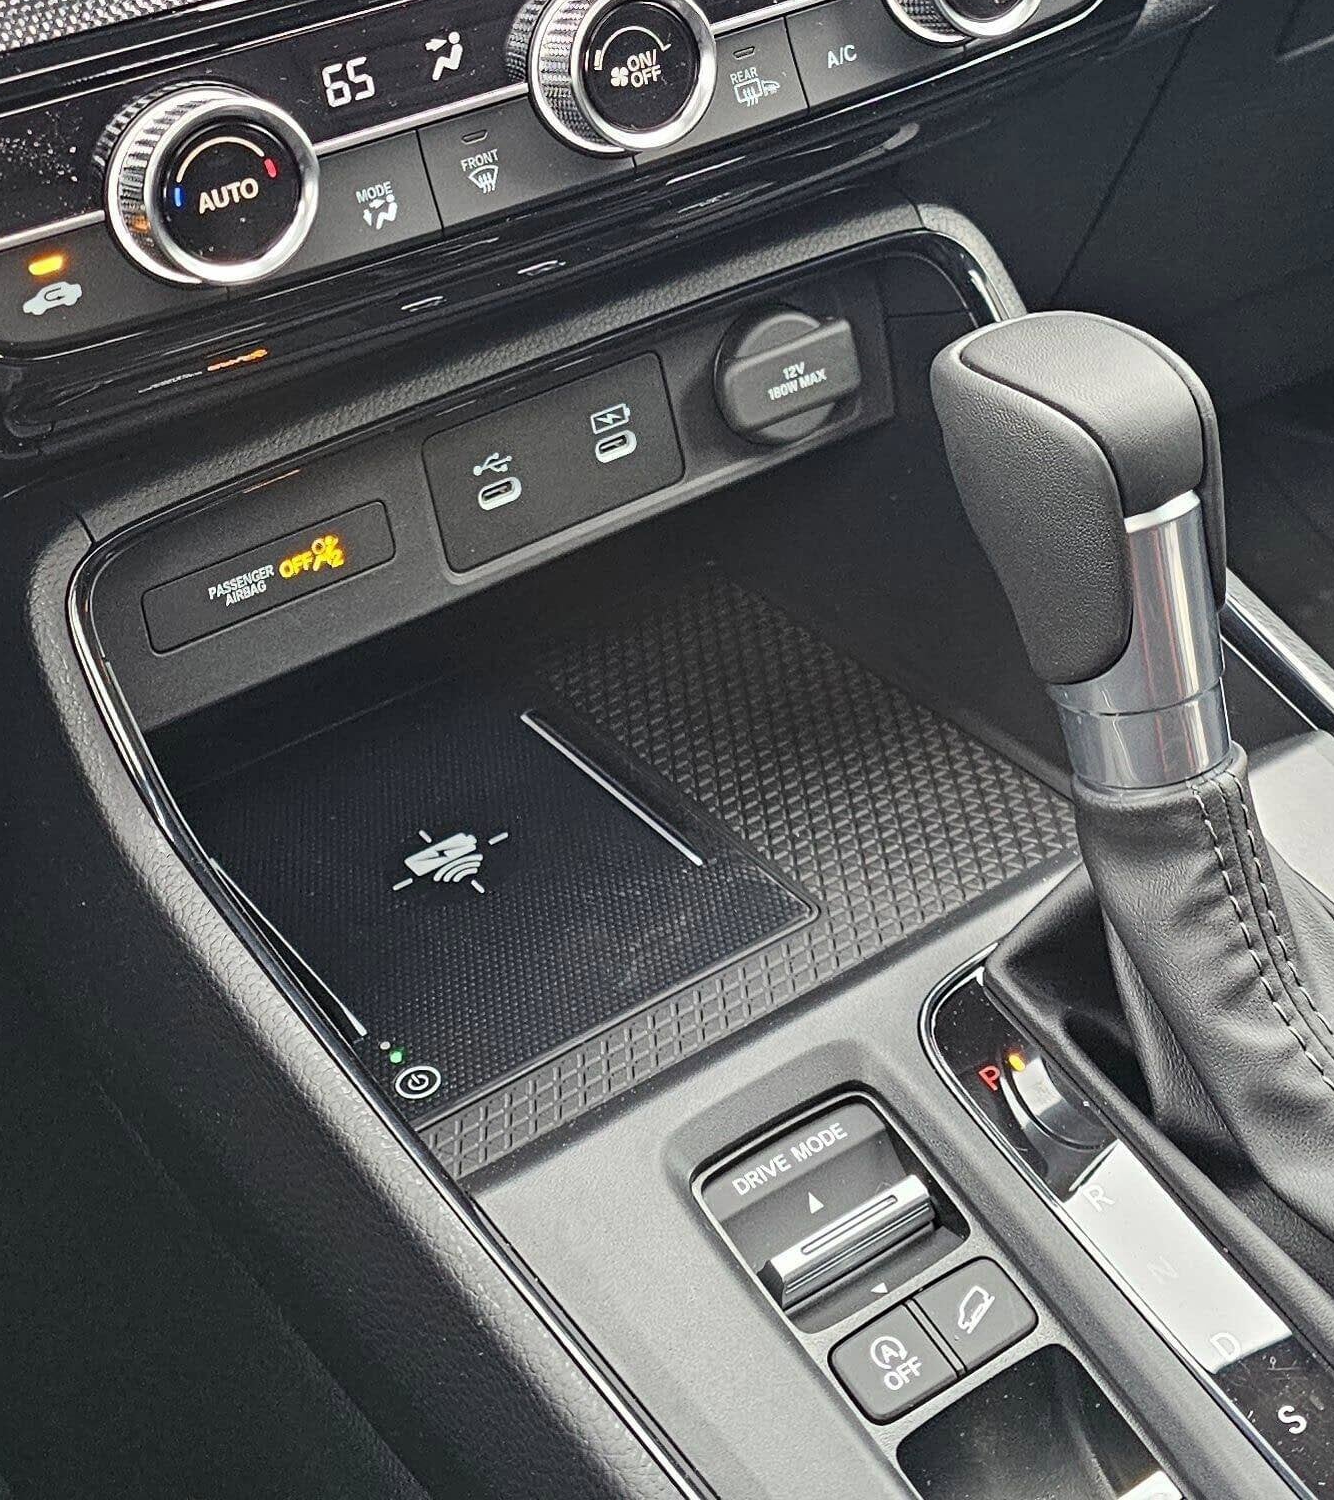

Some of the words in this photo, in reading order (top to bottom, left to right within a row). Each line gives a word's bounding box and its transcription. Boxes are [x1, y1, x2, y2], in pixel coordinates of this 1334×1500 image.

[626, 49, 658, 69] ON/
[826, 43, 858, 69] A/C
[321, 56, 376, 108] 65
[629, 64, 662, 88] OFF
[729, 67, 759, 85] REAR
[460, 148, 499, 173] FRONT
[197, 177, 260, 215] AUTO
[355, 180, 394, 205] MODE
[782, 361, 806, 381] 12V
[798, 367, 828, 390] MAX
[278, 550, 313, 579] OFF
[207, 564, 275, 601] PASSENGER
[225, 579, 268, 608] AIRBAG
[978, 1064, 1002, 1092] P
[731, 1151, 792, 1197] DRIVE
[790, 1121, 849, 1164] MODE
[1082, 1183, 1116, 1212] R
[1208, 1331, 1242, 1364] D
[883, 1355, 923, 1392] OFF
[1277, 1405, 1308, 1435] S
